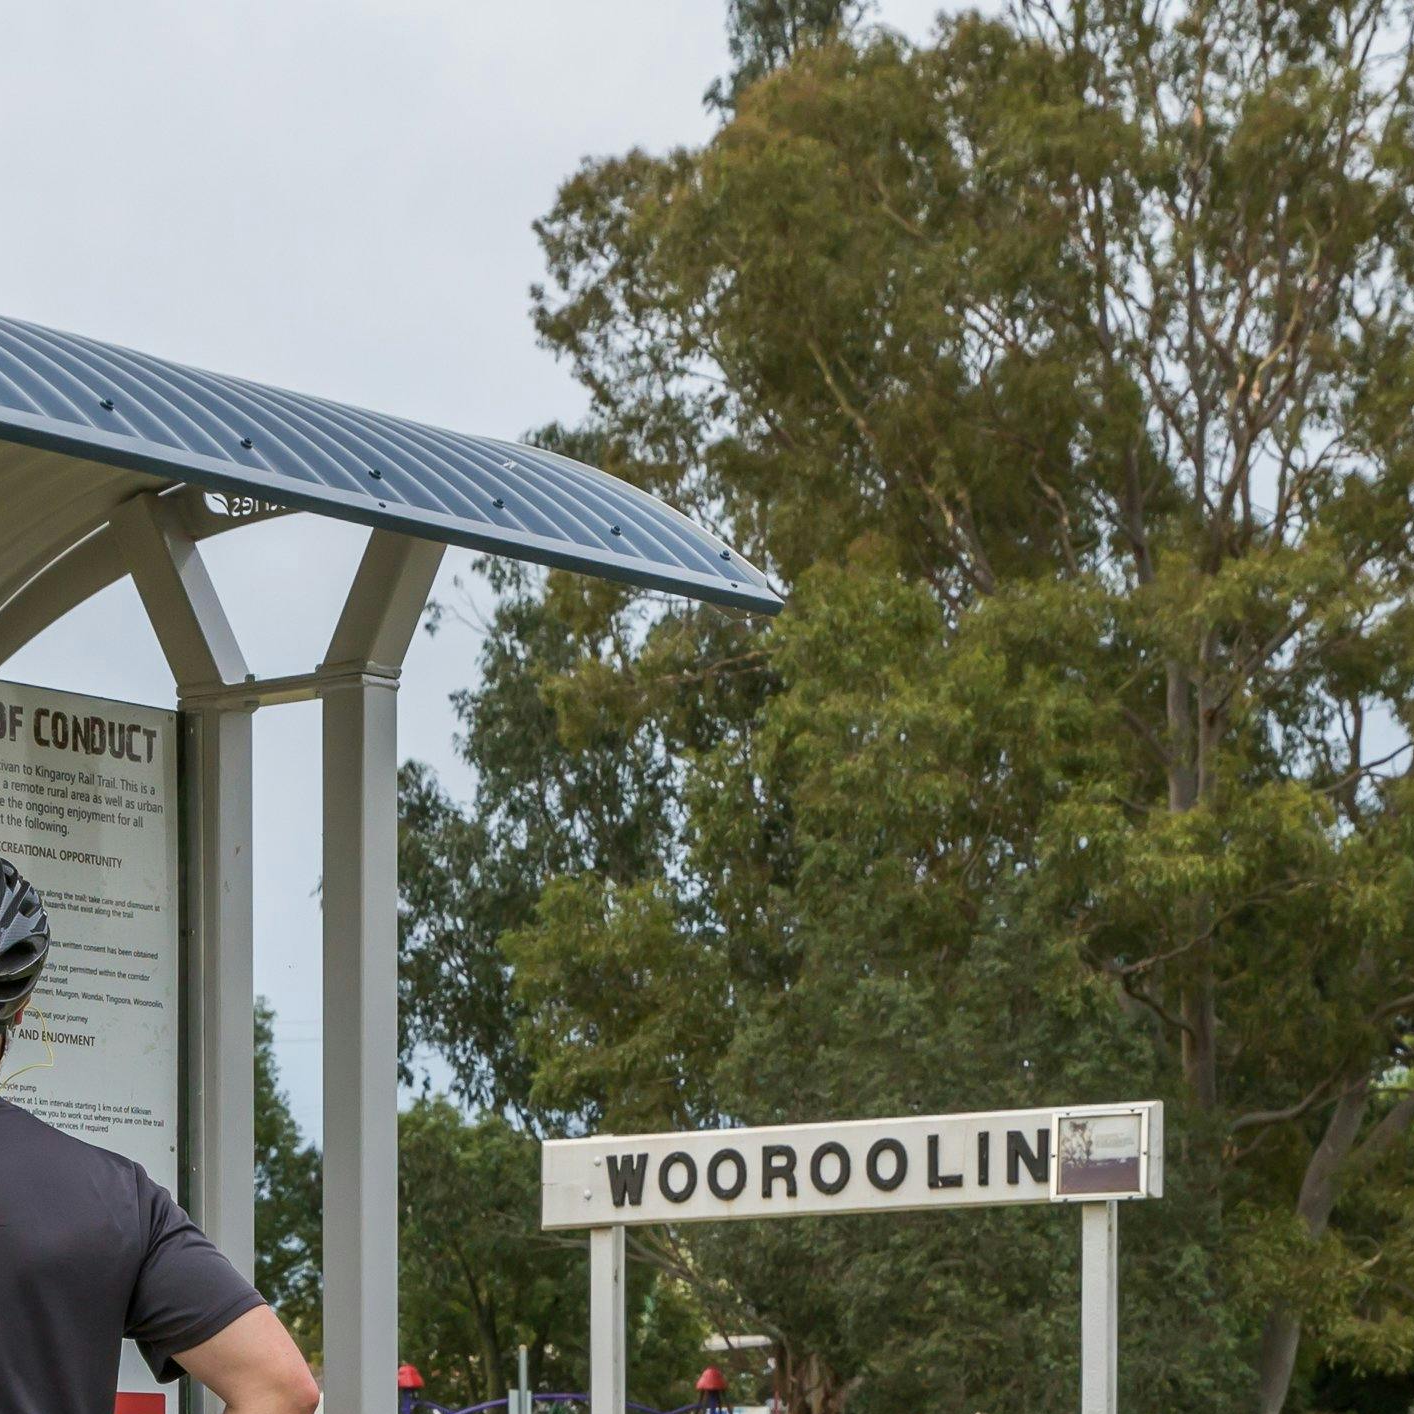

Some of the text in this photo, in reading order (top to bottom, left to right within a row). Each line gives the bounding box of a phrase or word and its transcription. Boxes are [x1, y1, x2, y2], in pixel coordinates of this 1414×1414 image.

[32, 706, 157, 764] CONDUCT
[22, 763, 33, 776] to
[34, 763, 76, 785] Kingaroy
[78, 771, 95, 786] Rail
[97, 774, 120, 789] Trail.
[120, 777, 138, 792] This
[140, 784, 147, 794] is
[149, 786, 158, 796] a
[2, 779, 8, 789] a
[10, 781, 46, 795] remote
[45, 784, 68, 798] rural
[70, 789, 91, 803] area
[91, 791, 103, 804] as
[103, 794, 122, 807] well
[124, 799, 136, 809] as
[136, 802, 164, 815] urban
[7, 795, 23, 809] the
[25, 796, 64, 819] ongoing
[66, 807, 115, 824] enjoyment
[117, 811, 131, 826] for
[131, 814, 143, 828] all
[5, 812, 24, 827] the
[24, 814, 69, 837] following.
[59, 849, 122, 868] OPPORTUNITY
[18, 1027, 95, 1046] AND ENJOYMENT
[606, 1127, 1050, 1207] WOOROOLIN
